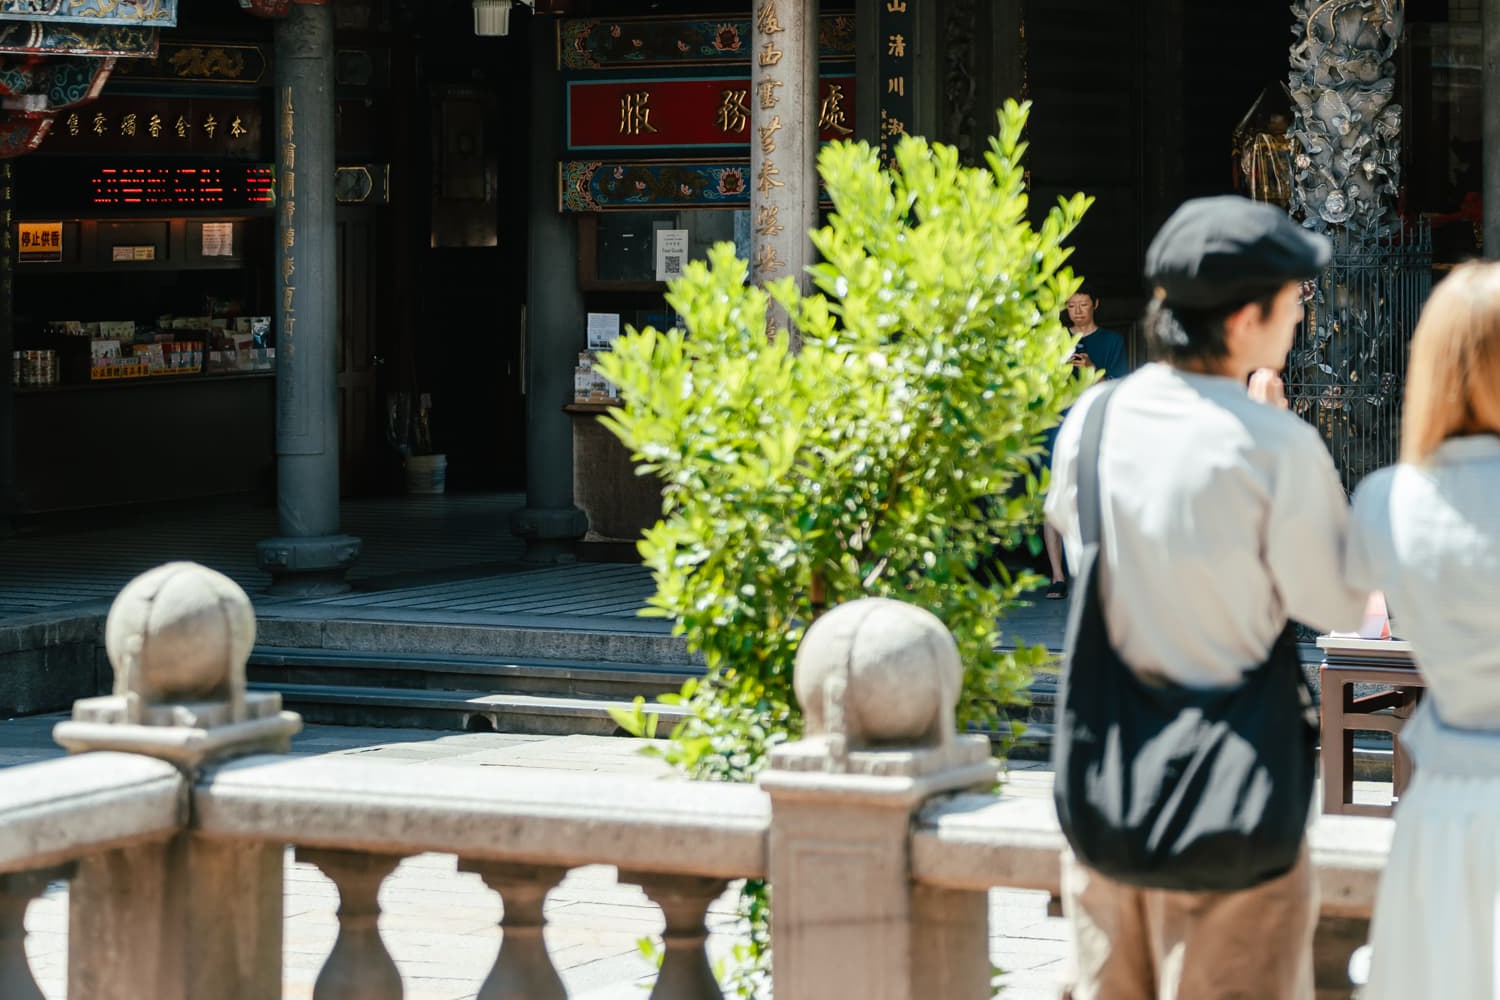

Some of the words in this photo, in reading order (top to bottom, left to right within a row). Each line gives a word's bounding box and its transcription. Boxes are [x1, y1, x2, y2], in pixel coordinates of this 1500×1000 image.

[49, 112, 248, 139] 本寺金香燭零售
